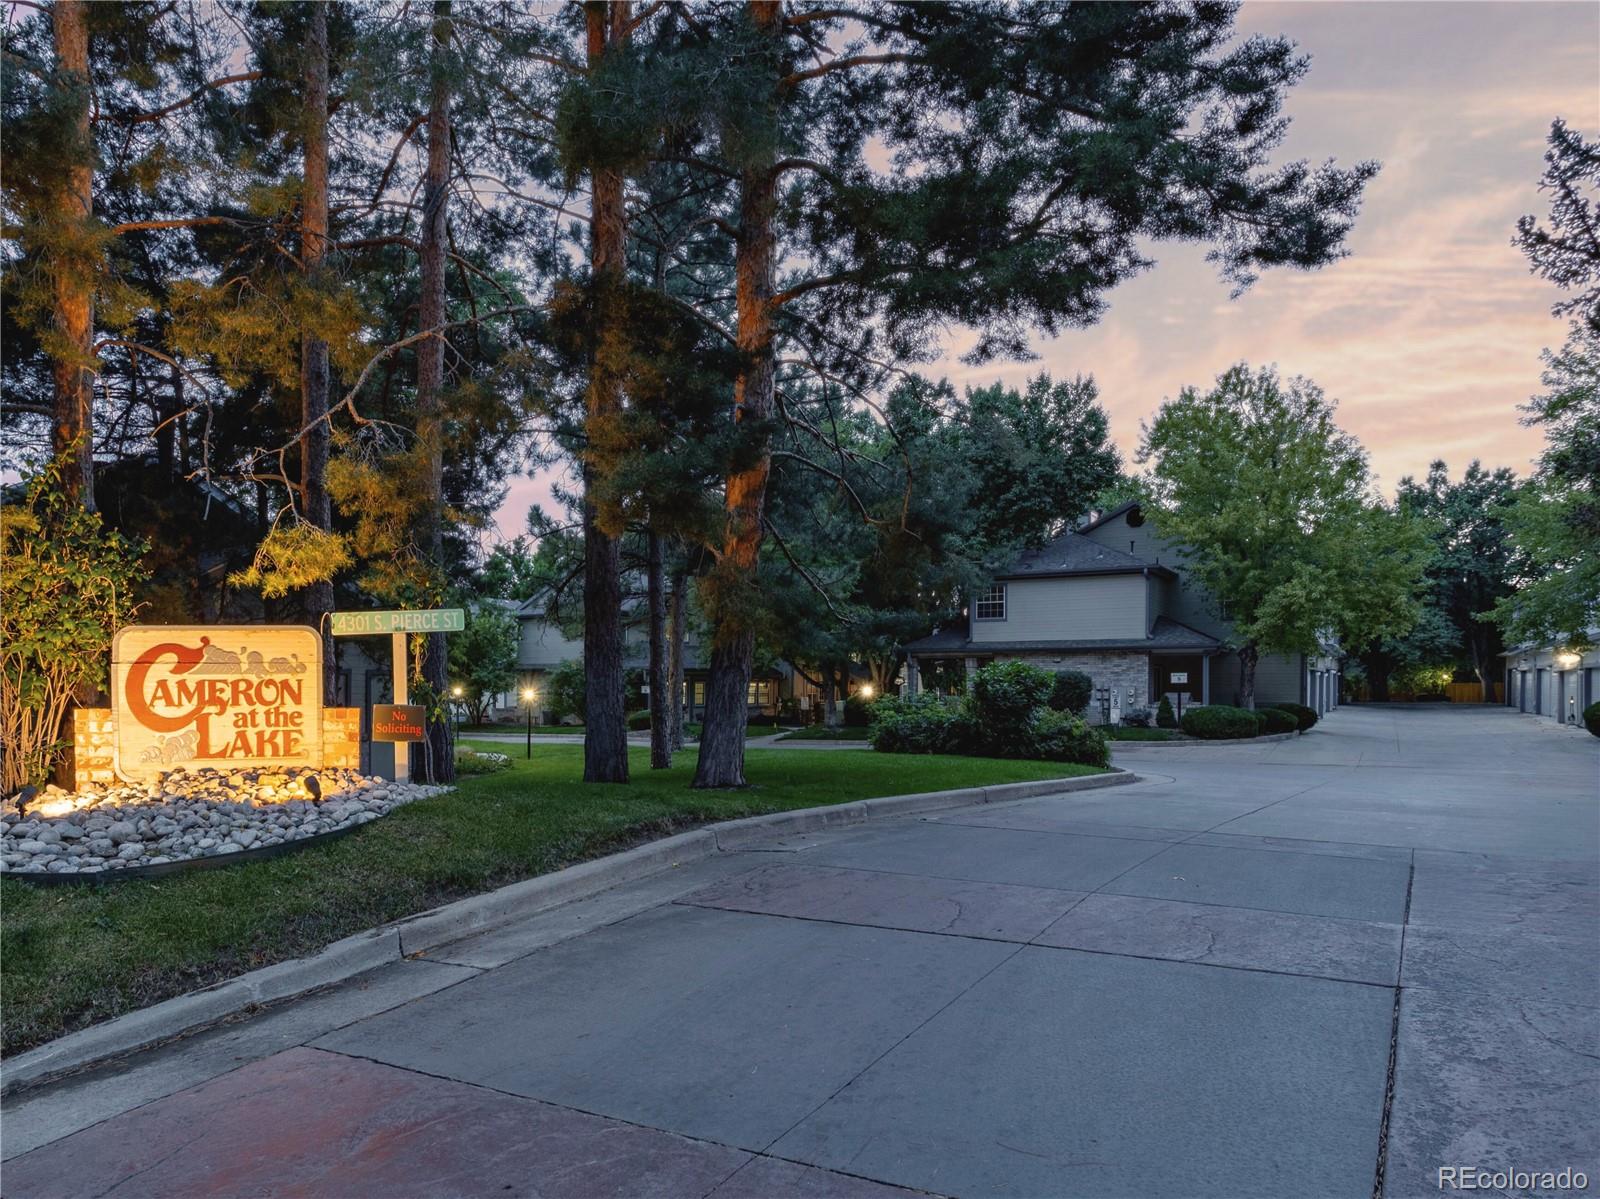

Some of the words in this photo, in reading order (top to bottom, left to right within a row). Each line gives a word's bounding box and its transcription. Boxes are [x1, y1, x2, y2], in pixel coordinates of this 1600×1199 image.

[338, 615, 370, 632] 4301
[374, 615, 387, 631] S.
[391, 612, 439, 630] PIERCE
[443, 612, 460, 629] ST
[125, 636, 304, 733] CAMERON
[232, 708, 260, 729] at
[263, 706, 305, 728] the
[392, 710, 407, 721] No
[193, 712, 304, 760] LAKE
[375, 722, 423, 737] Soliciting
